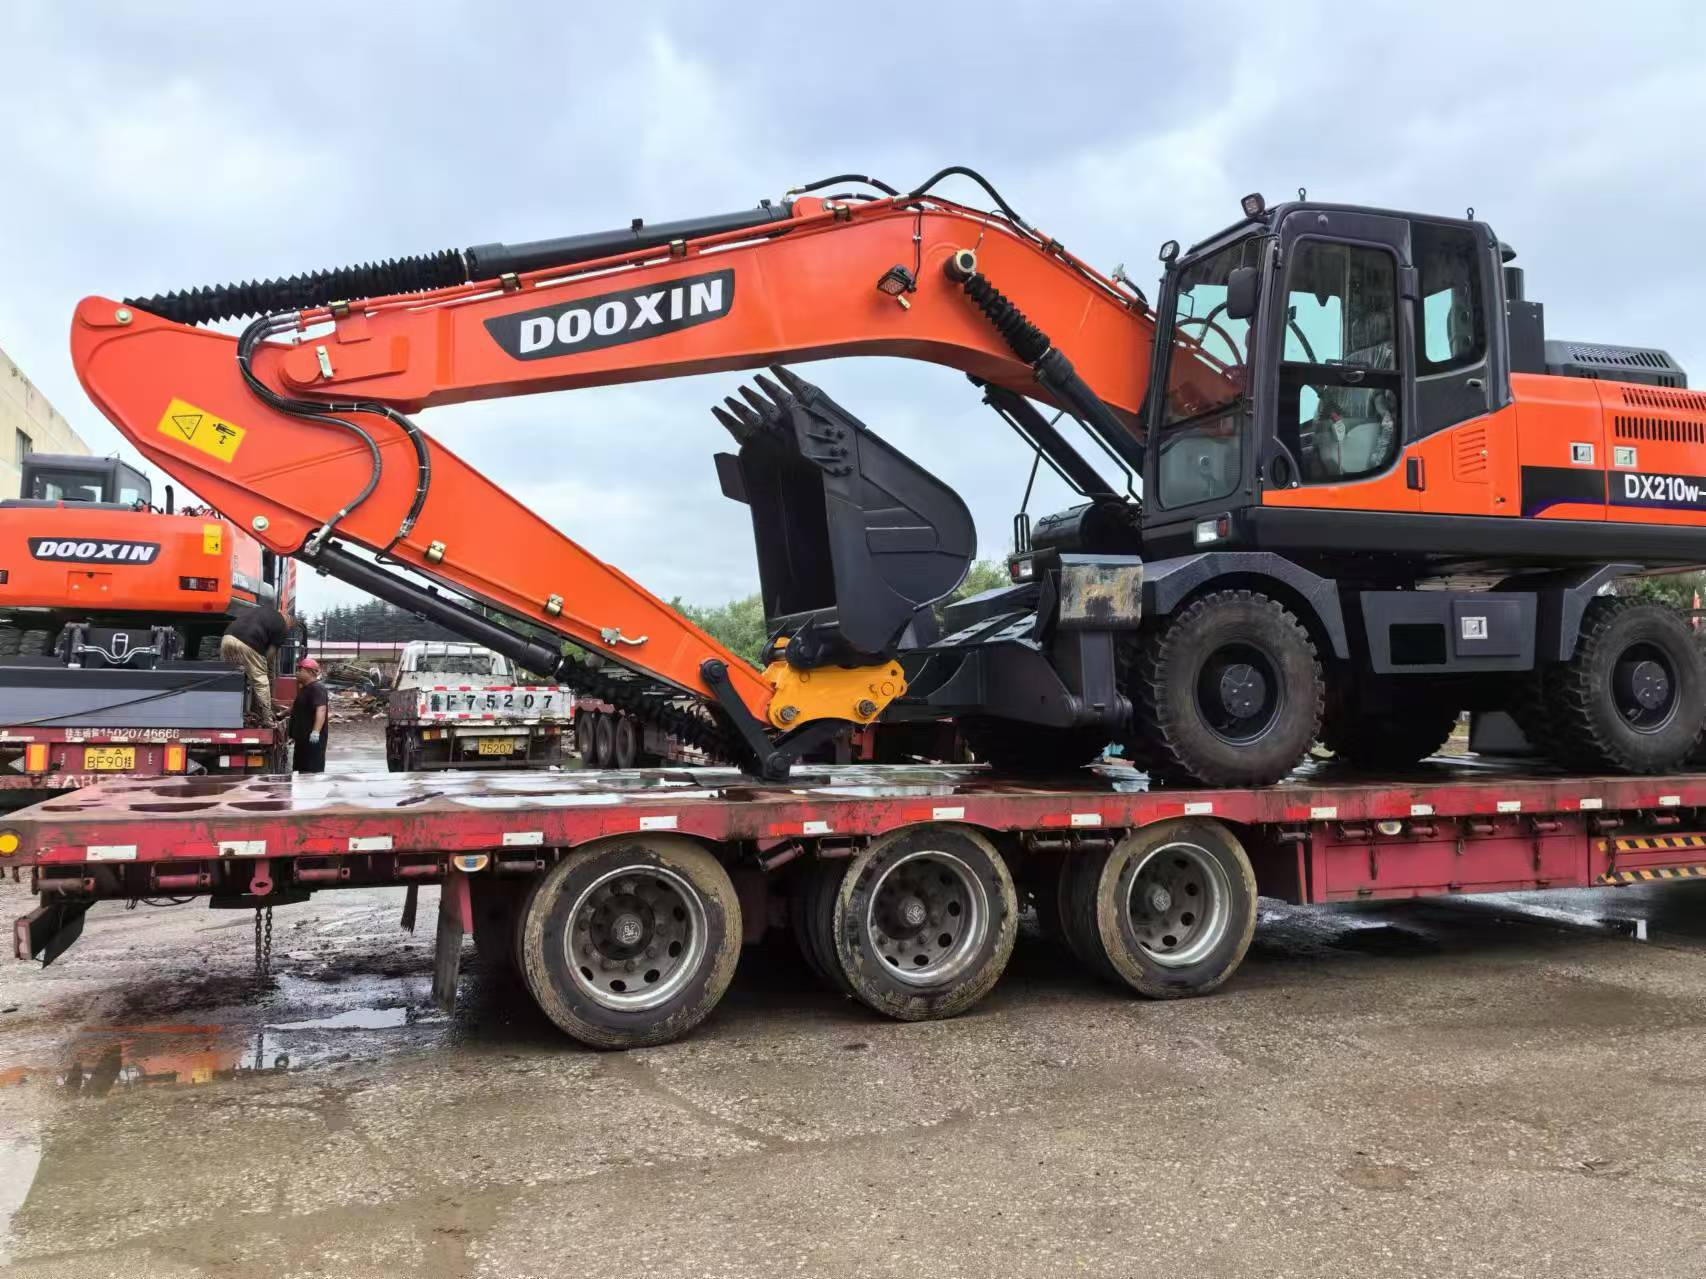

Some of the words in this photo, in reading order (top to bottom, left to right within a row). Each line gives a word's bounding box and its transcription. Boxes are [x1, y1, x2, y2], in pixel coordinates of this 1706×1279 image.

[520, 279, 723, 354] DOOXIN
[36, 541, 155, 561] DOOXIN
[481, 743, 512, 753] 75207
